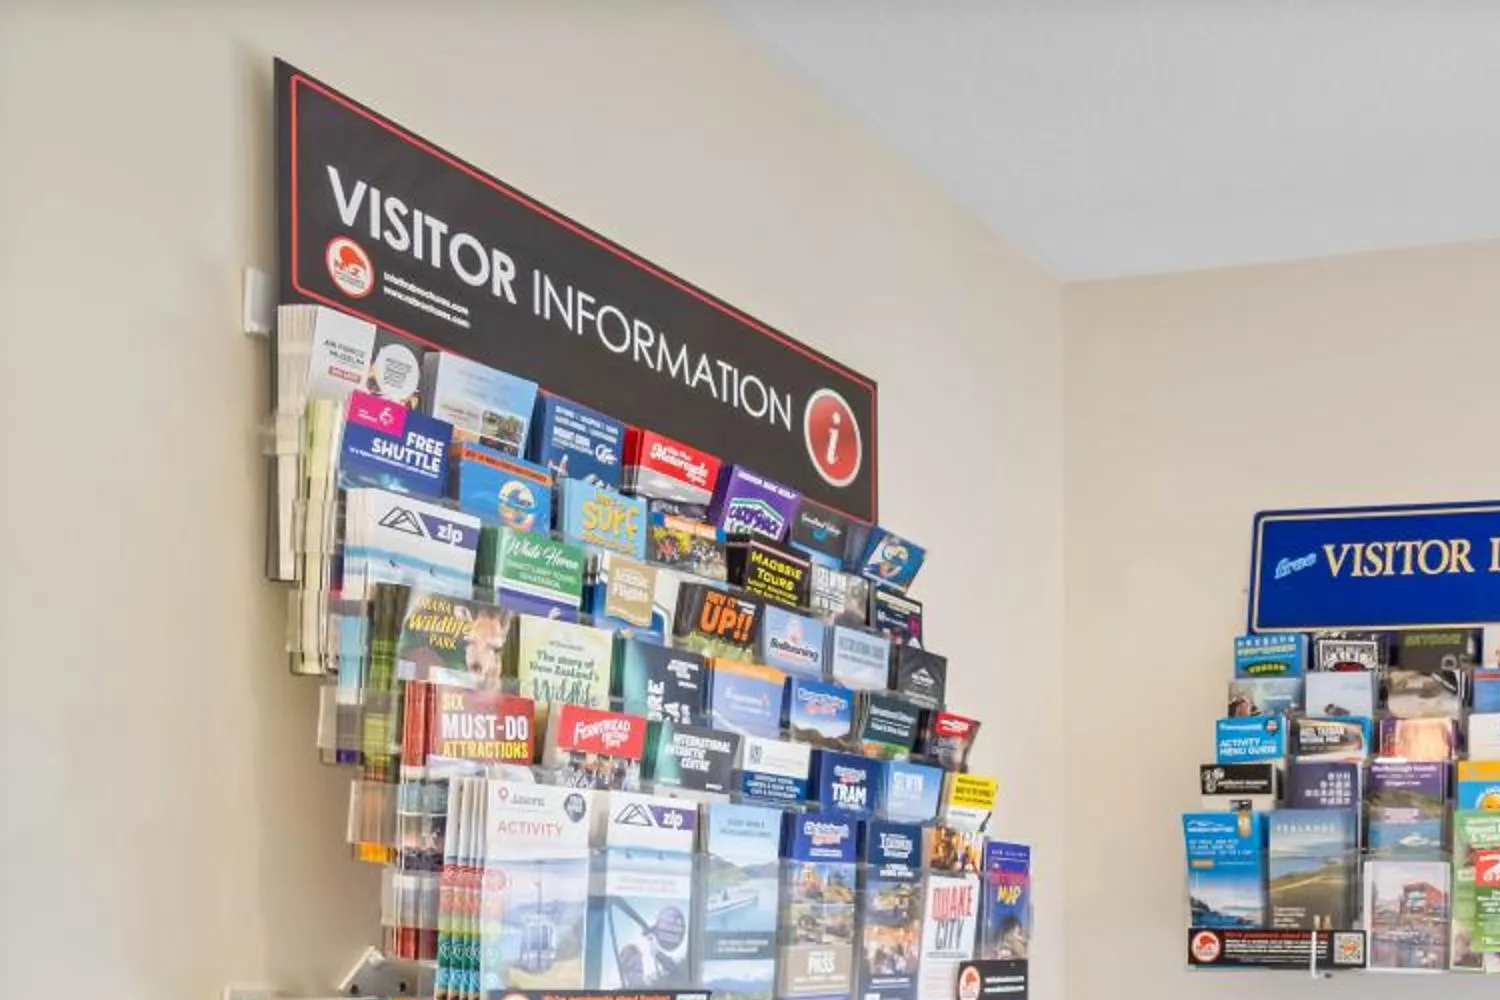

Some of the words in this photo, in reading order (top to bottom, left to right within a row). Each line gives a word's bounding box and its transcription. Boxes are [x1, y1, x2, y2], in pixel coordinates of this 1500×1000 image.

[327, 165, 517, 304] VISITOR
[533, 269, 792, 432] INFORMATION
[371, 437, 441, 473] SHUTTLE
[405, 431, 443, 457] FREE
[437, 524, 463, 545] zip
[1324, 539, 1475, 578] VISITOR
[537, 650, 553, 663] The
[584, 657, 595, 670] of
[442, 713, 529, 740] MUST-DO
[442, 740, 529, 760] ATTRACTIONS
[832, 783, 867, 806] TRAM
[497, 820, 563, 837] ACTIVITY
[663, 810, 684, 831] zip
[932, 885, 974, 921] QUAKE
[935, 919, 965, 951] CITY
